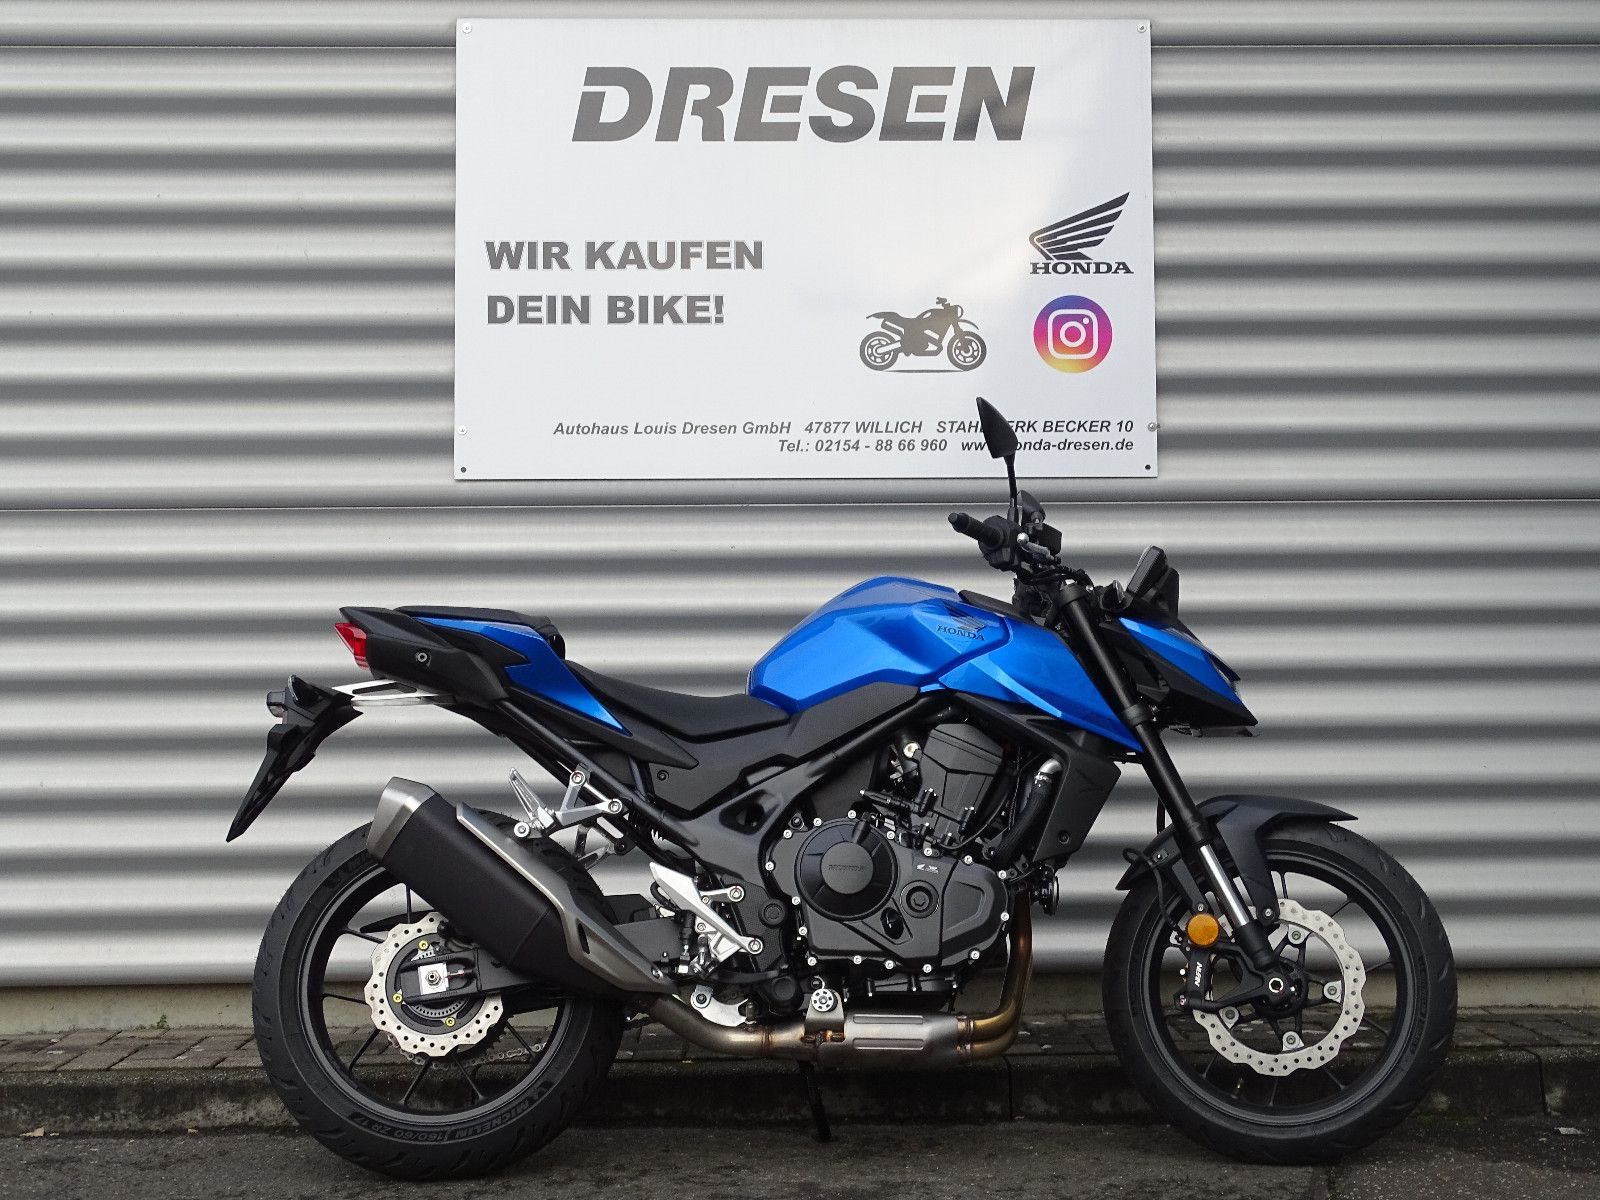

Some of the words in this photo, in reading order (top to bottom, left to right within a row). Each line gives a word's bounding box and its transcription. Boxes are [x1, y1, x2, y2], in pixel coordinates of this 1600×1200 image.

[571, 64, 1036, 143] DRESEN
[485, 240, 571, 270] WIR
[585, 240, 764, 270] KAUFEN
[1029, 261, 1134, 275] HONDA
[487, 294, 591, 325] DEIN
[607, 294, 725, 325] BIKE!
[553, 421, 629, 435] Autohaus
[633, 421, 677, 435] Louis
[681, 421, 737, 435] Dresen
[742, 420, 792, 434] GmbH
[804, 420, 850, 434] 47877
[855, 420, 923, 434] WILLICH
[1043, 419, 1111, 433] BECKER
[1117, 419, 1134, 433] 10
[778, 439, 810, 452] Tel.:
[815, 439, 860, 452] 02154
[875, 439, 893, 452] 88
[898, 439, 916, 452] 66
[920, 438, 948, 451] 960
[936, 624, 985, 641] HONDA
[353, 1115, 369, 1126] 17
[455, 1099, 531, 1139] MICHELIN
[371, 1122, 392, 1134] ZR
